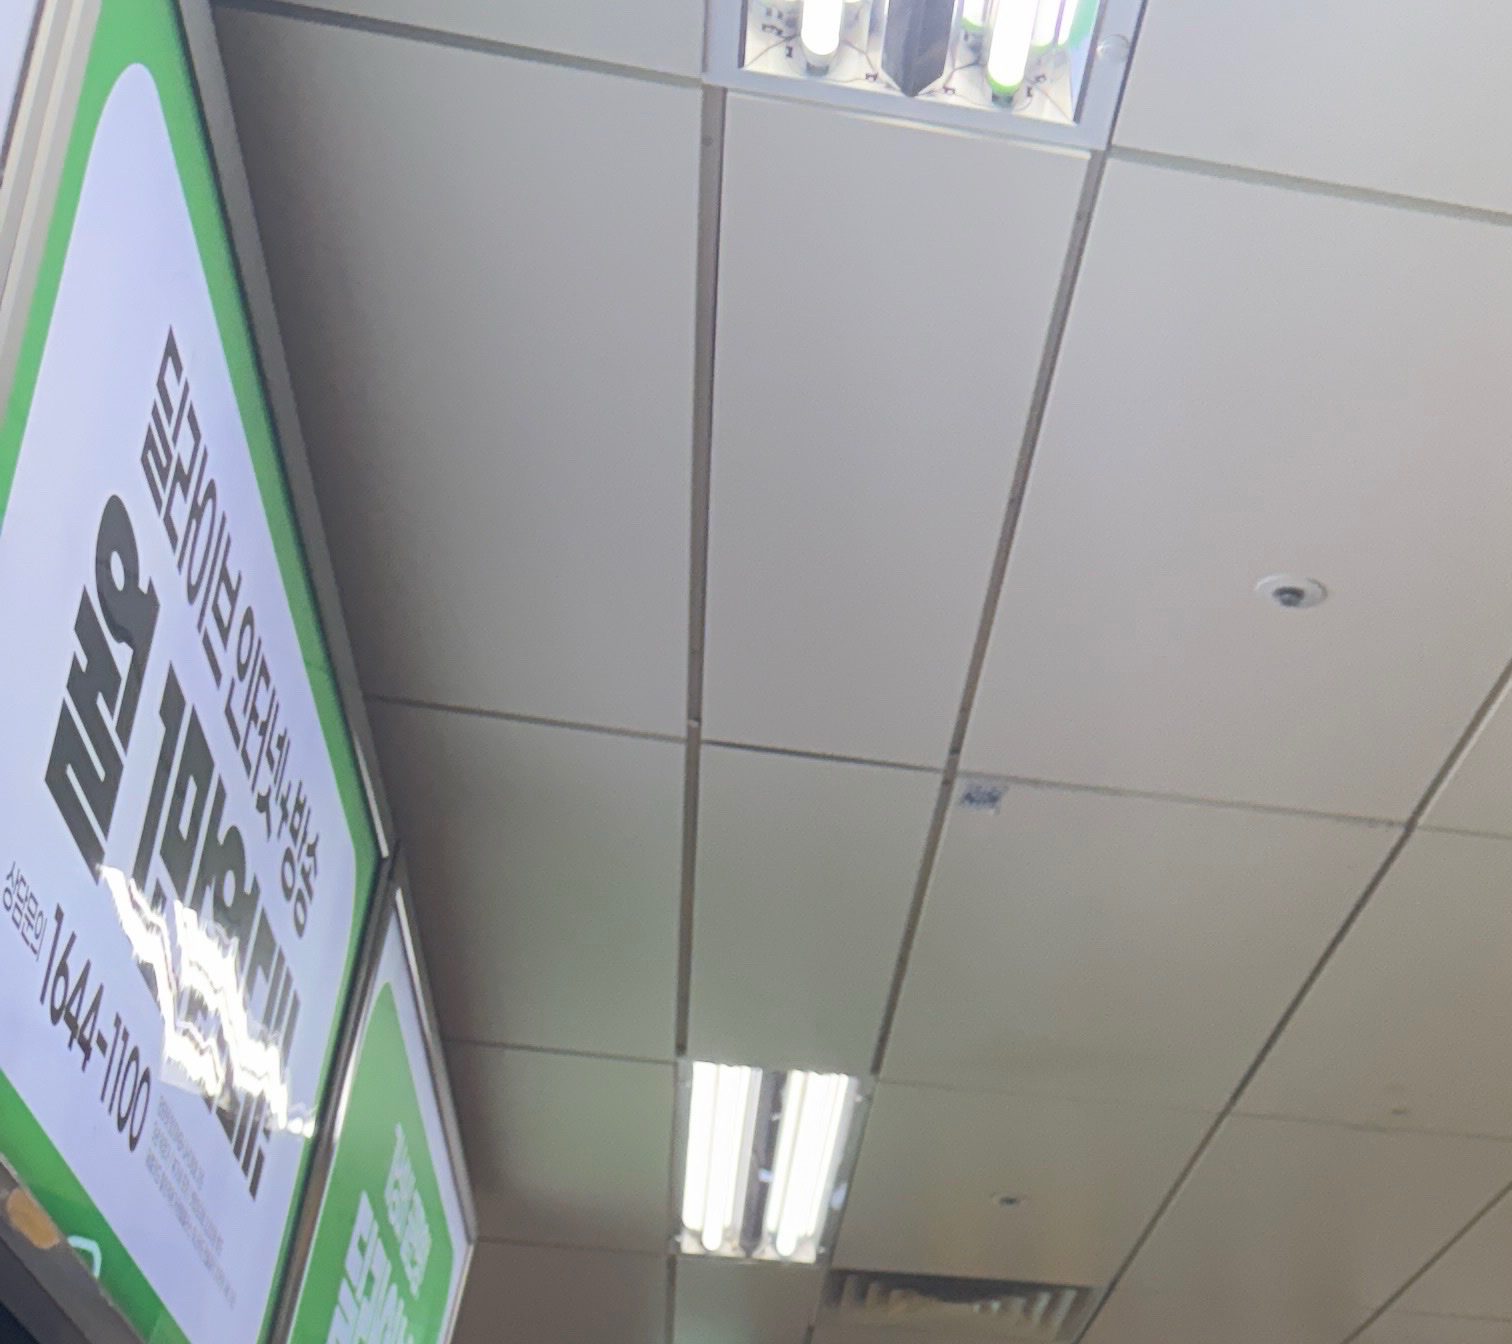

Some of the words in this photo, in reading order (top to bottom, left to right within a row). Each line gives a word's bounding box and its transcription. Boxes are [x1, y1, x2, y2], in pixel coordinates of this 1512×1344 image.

[45, 494, 161, 885] 월
[140, 325, 242, 689] 딜라이브
[223, 606, 320, 938] 인터넷+방송
[2, 861, 47, 961] 상담문의
[40, 903, 152, 1153] 1644-1100
